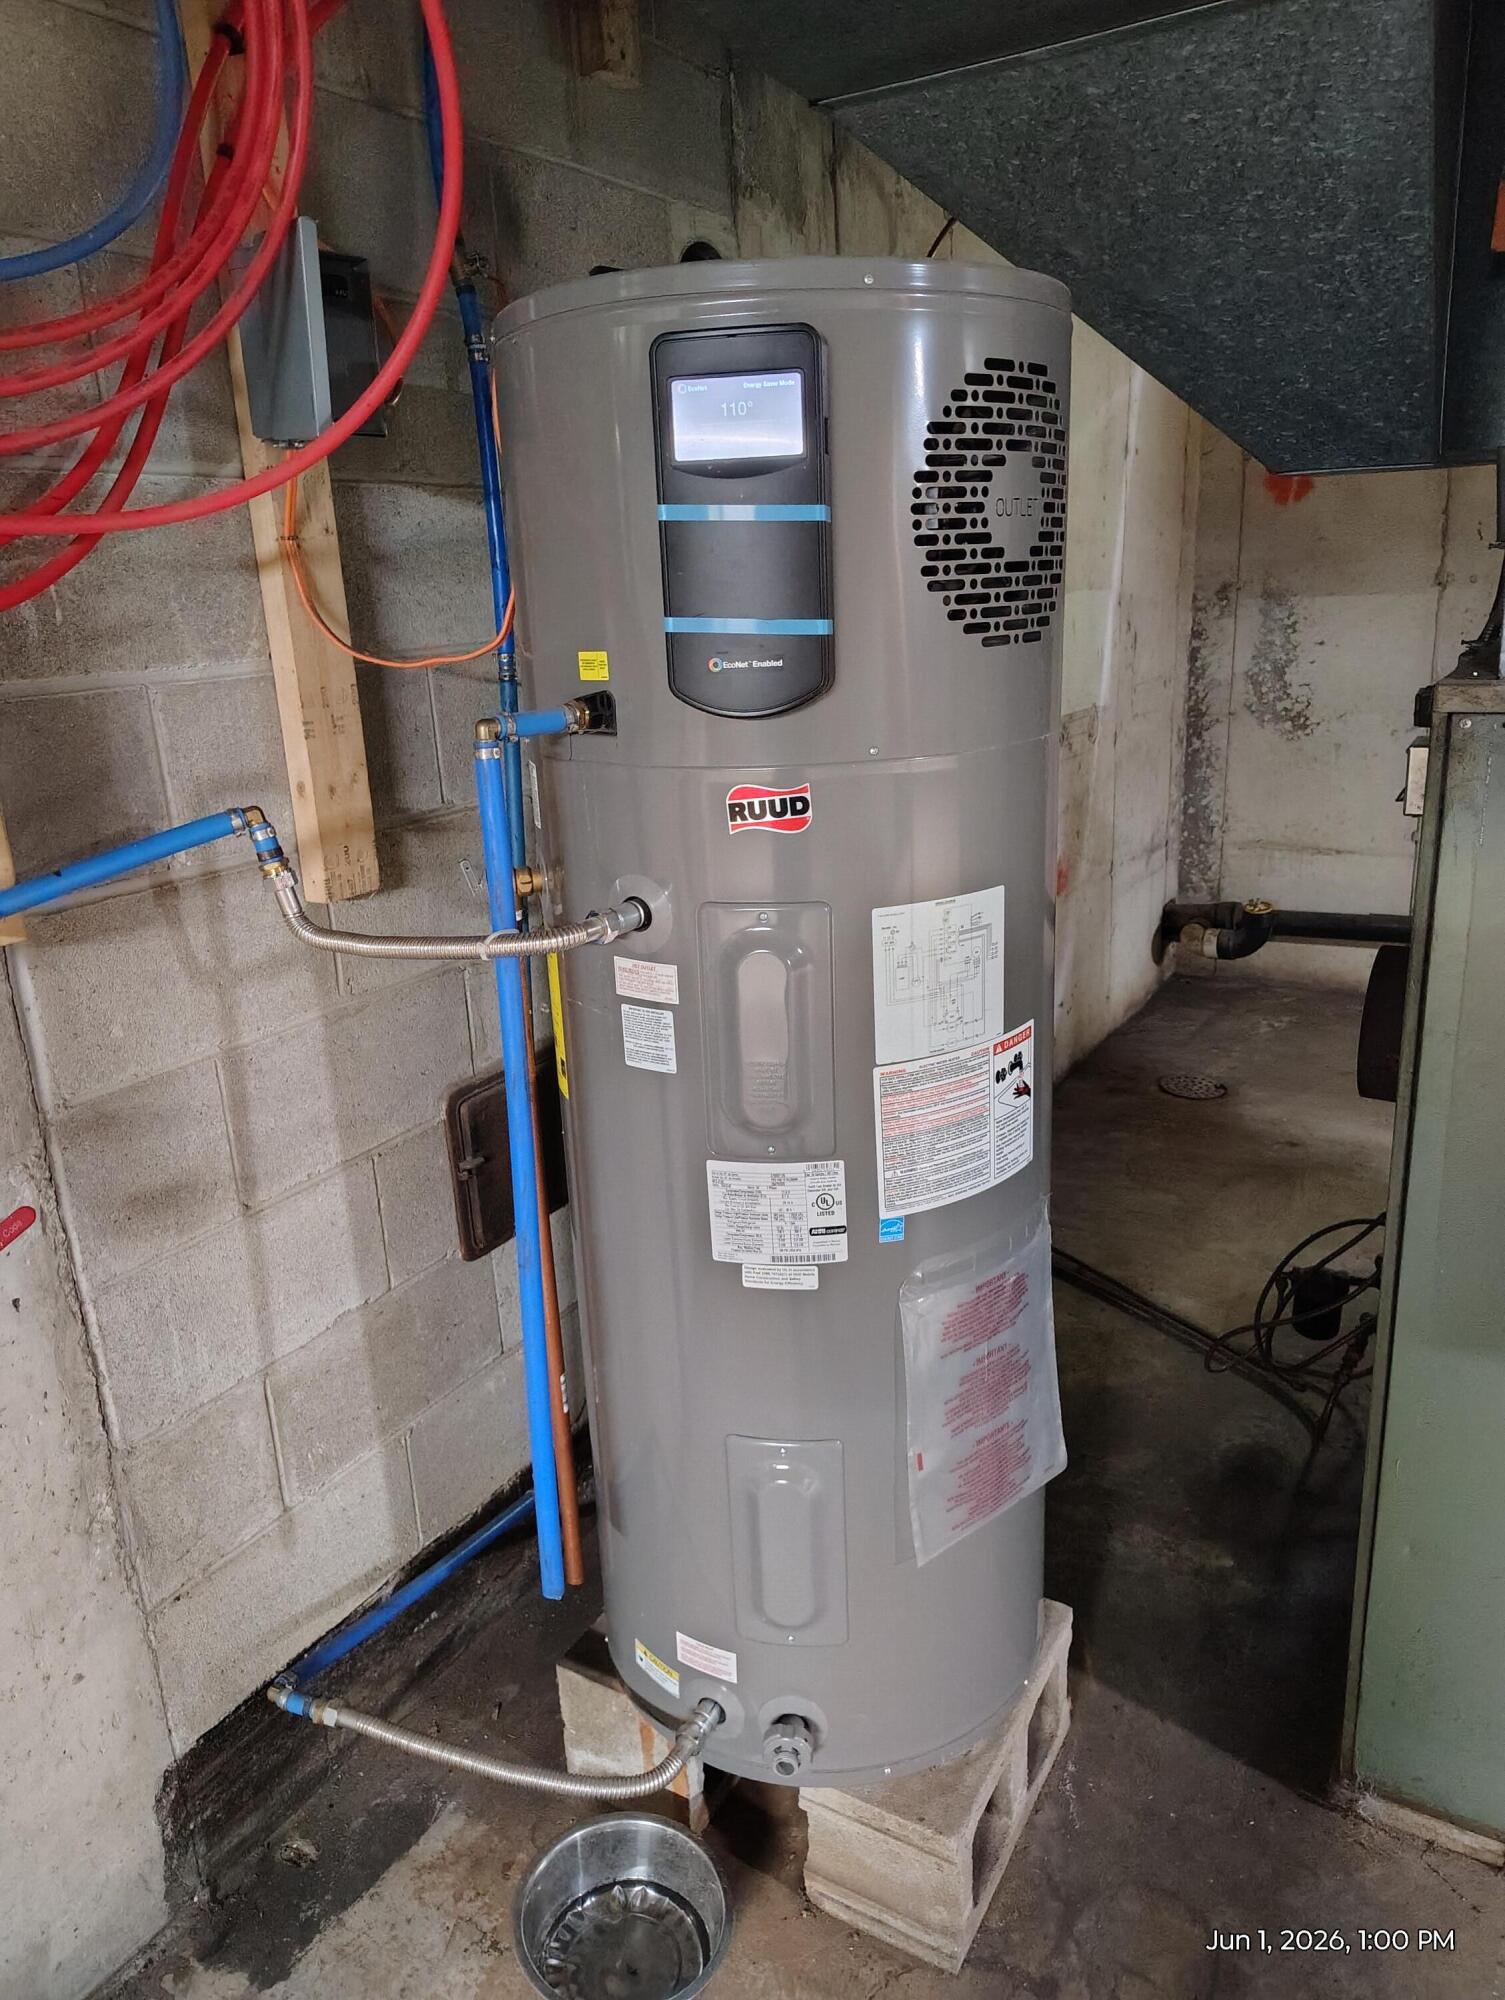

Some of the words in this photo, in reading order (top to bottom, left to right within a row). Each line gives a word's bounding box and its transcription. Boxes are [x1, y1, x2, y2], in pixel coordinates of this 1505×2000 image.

[995, 497, 1039, 517] OUTLET
[752, 659, 783, 668] Enabled
[728, 795, 810, 823] RUUD
[1004, 1028, 1031, 1050] DANGER
